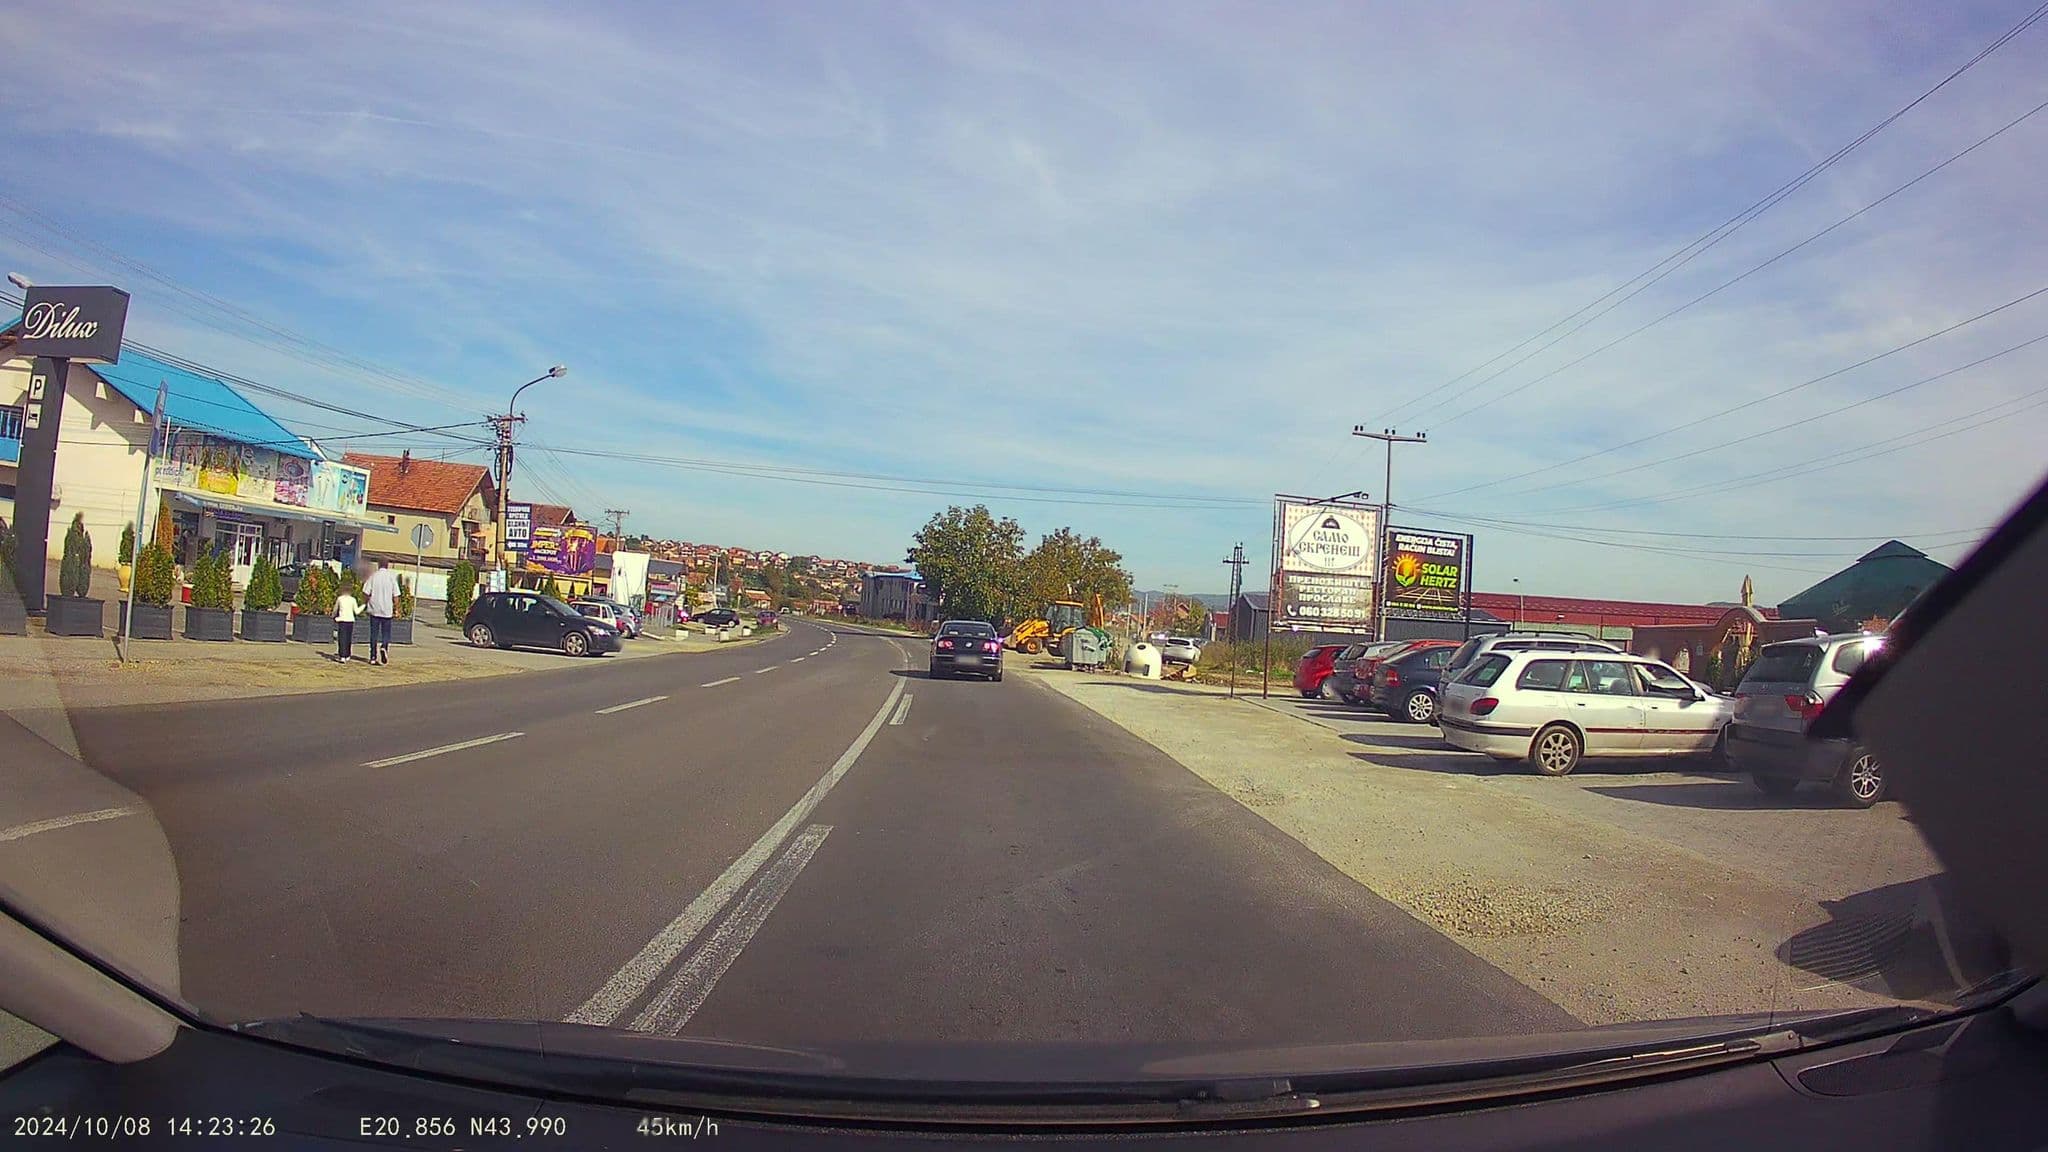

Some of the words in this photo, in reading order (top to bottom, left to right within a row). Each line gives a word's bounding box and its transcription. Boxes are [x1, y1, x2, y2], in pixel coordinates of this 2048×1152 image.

[23, 302, 98, 339] Dilux
[33, 378, 42, 396] P
[1313, 530, 1349, 543] САМО
[1299, 542, 1360, 557] СКРЕНЕШ
[1421, 563, 1458, 577] SOLAR
[1420, 575, 1457, 588] HERTZ
[1299, 606, 1319, 617] 060
